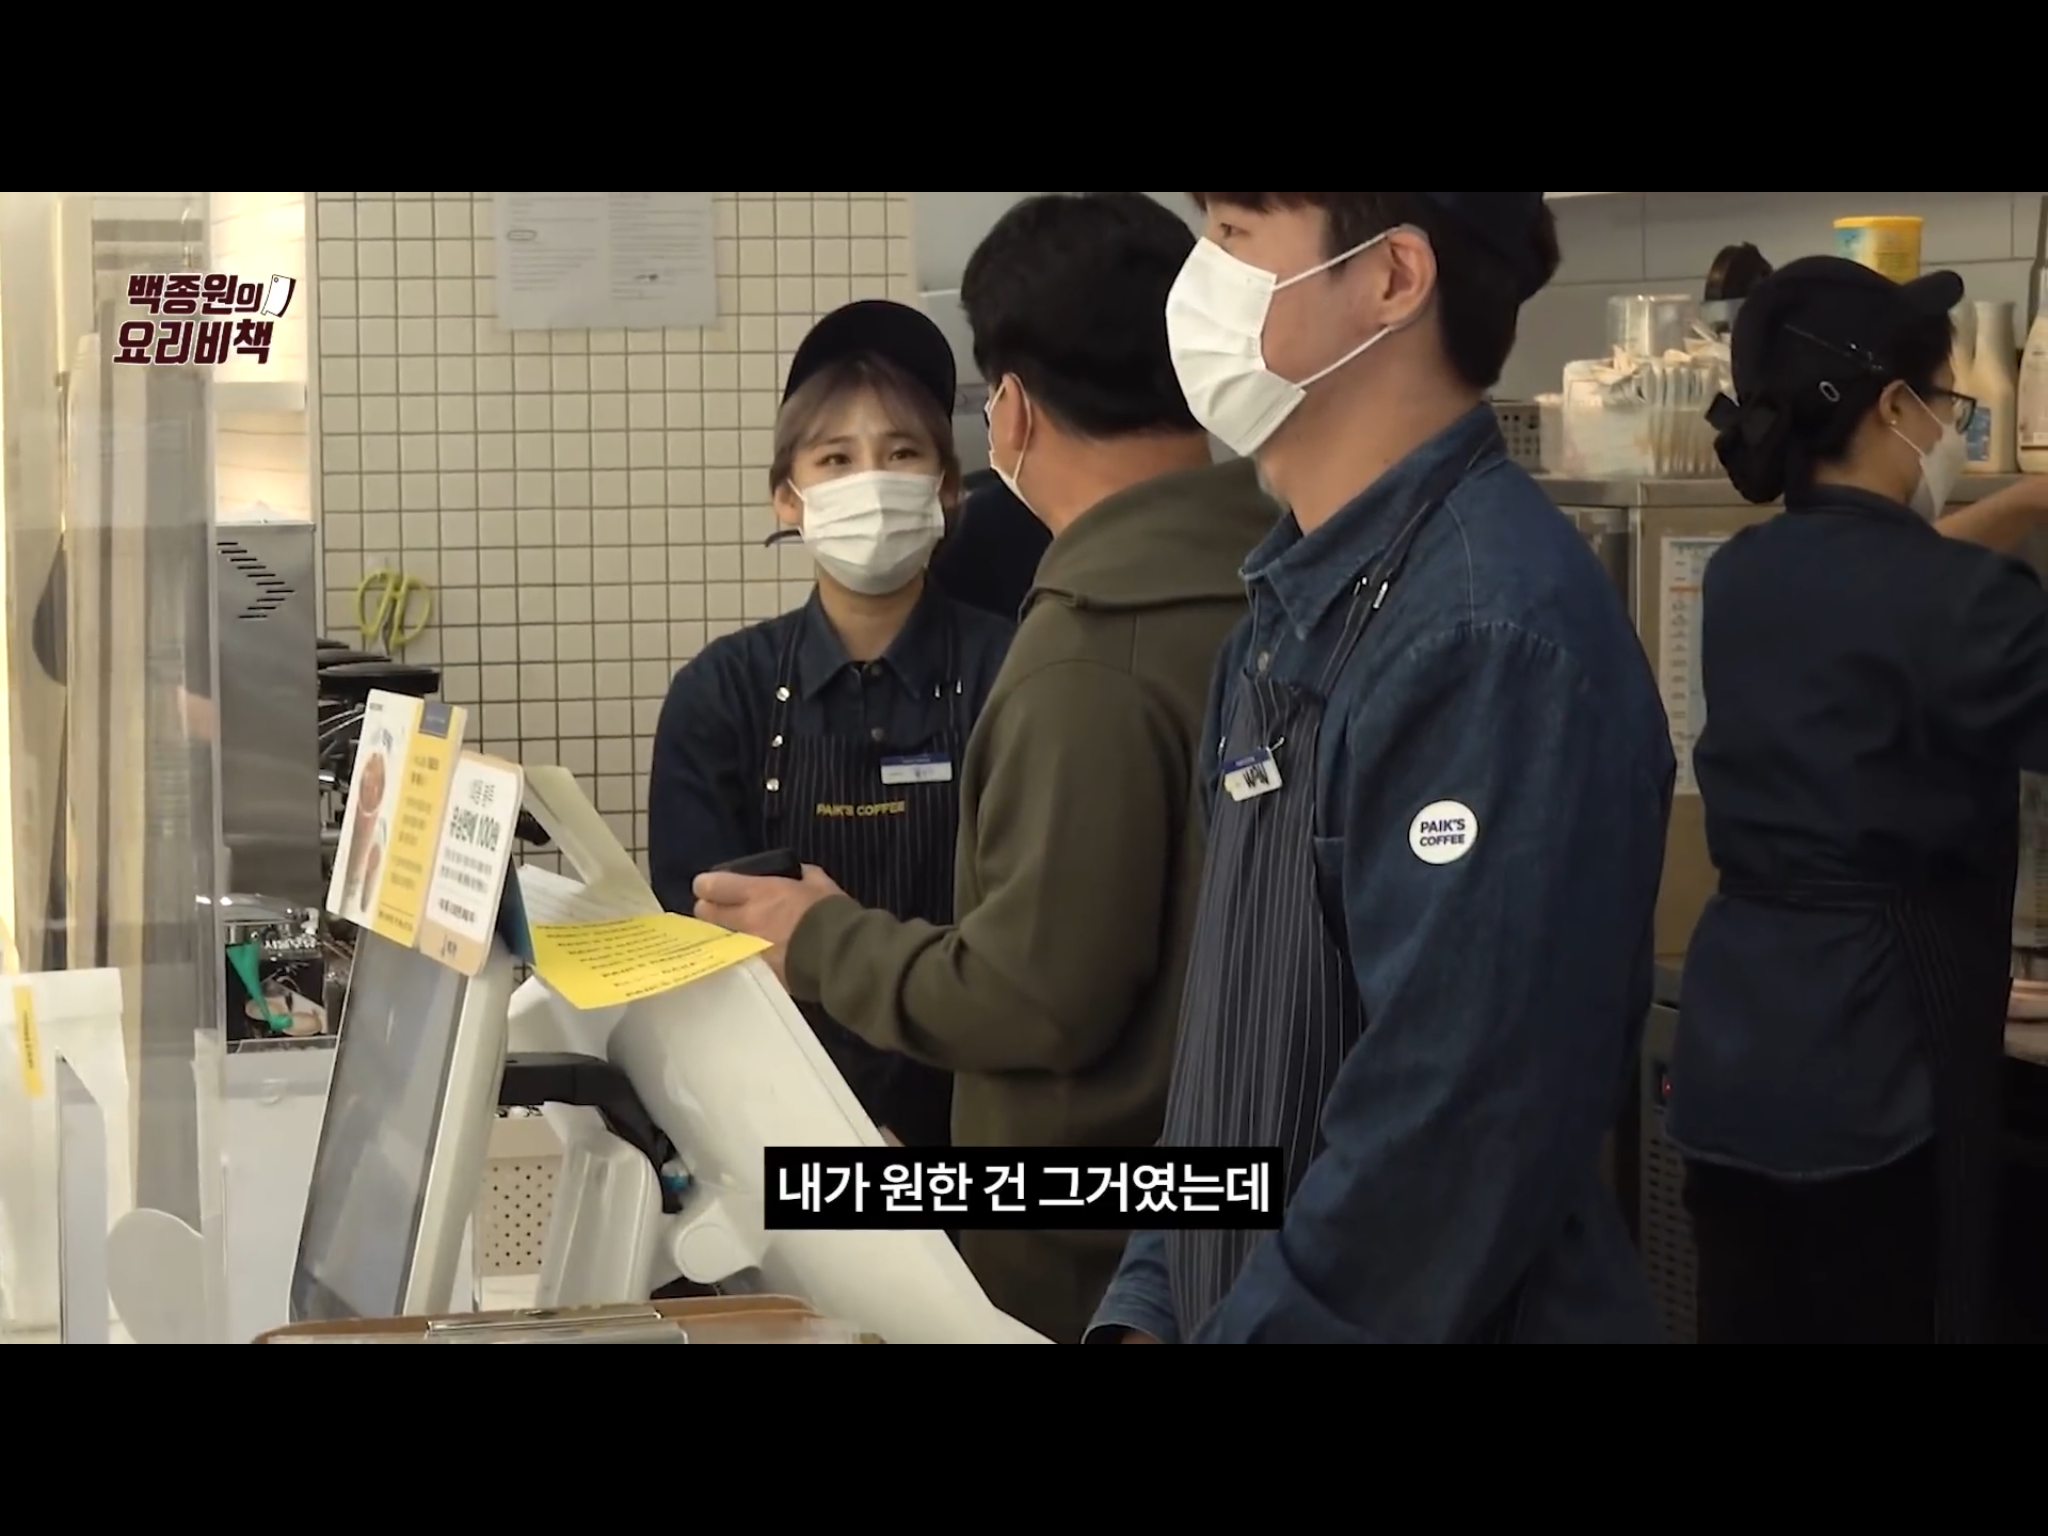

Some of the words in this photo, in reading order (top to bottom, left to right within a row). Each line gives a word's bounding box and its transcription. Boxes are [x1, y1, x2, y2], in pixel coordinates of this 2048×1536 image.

[856, 800, 906, 817] COFFEE
[1420, 818, 1466, 833] PAIK'S
[1420, 834, 1466, 847] COFFEE
